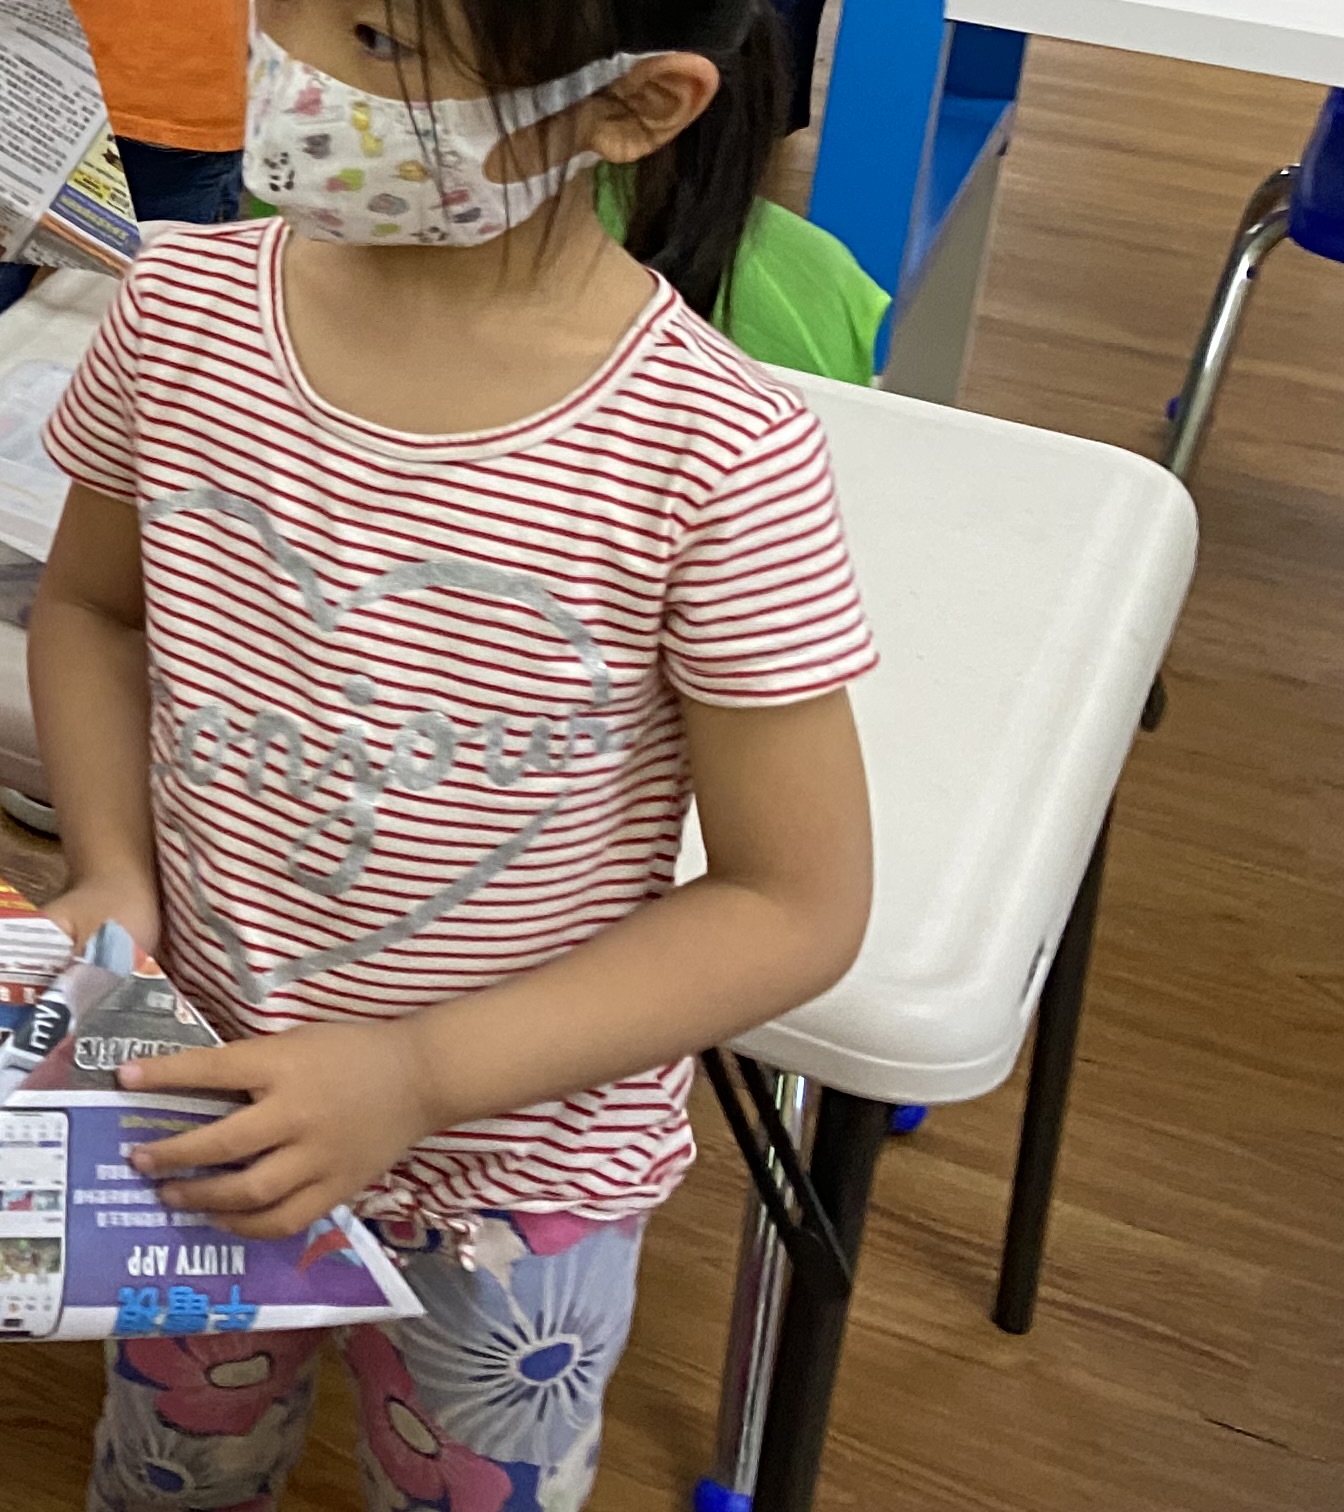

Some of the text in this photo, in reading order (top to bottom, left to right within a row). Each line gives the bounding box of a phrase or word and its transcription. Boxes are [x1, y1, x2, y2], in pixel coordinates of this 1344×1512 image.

[150, 675, 630, 897] onjour
[127, 1244, 246, 1276] NIUTV APP
